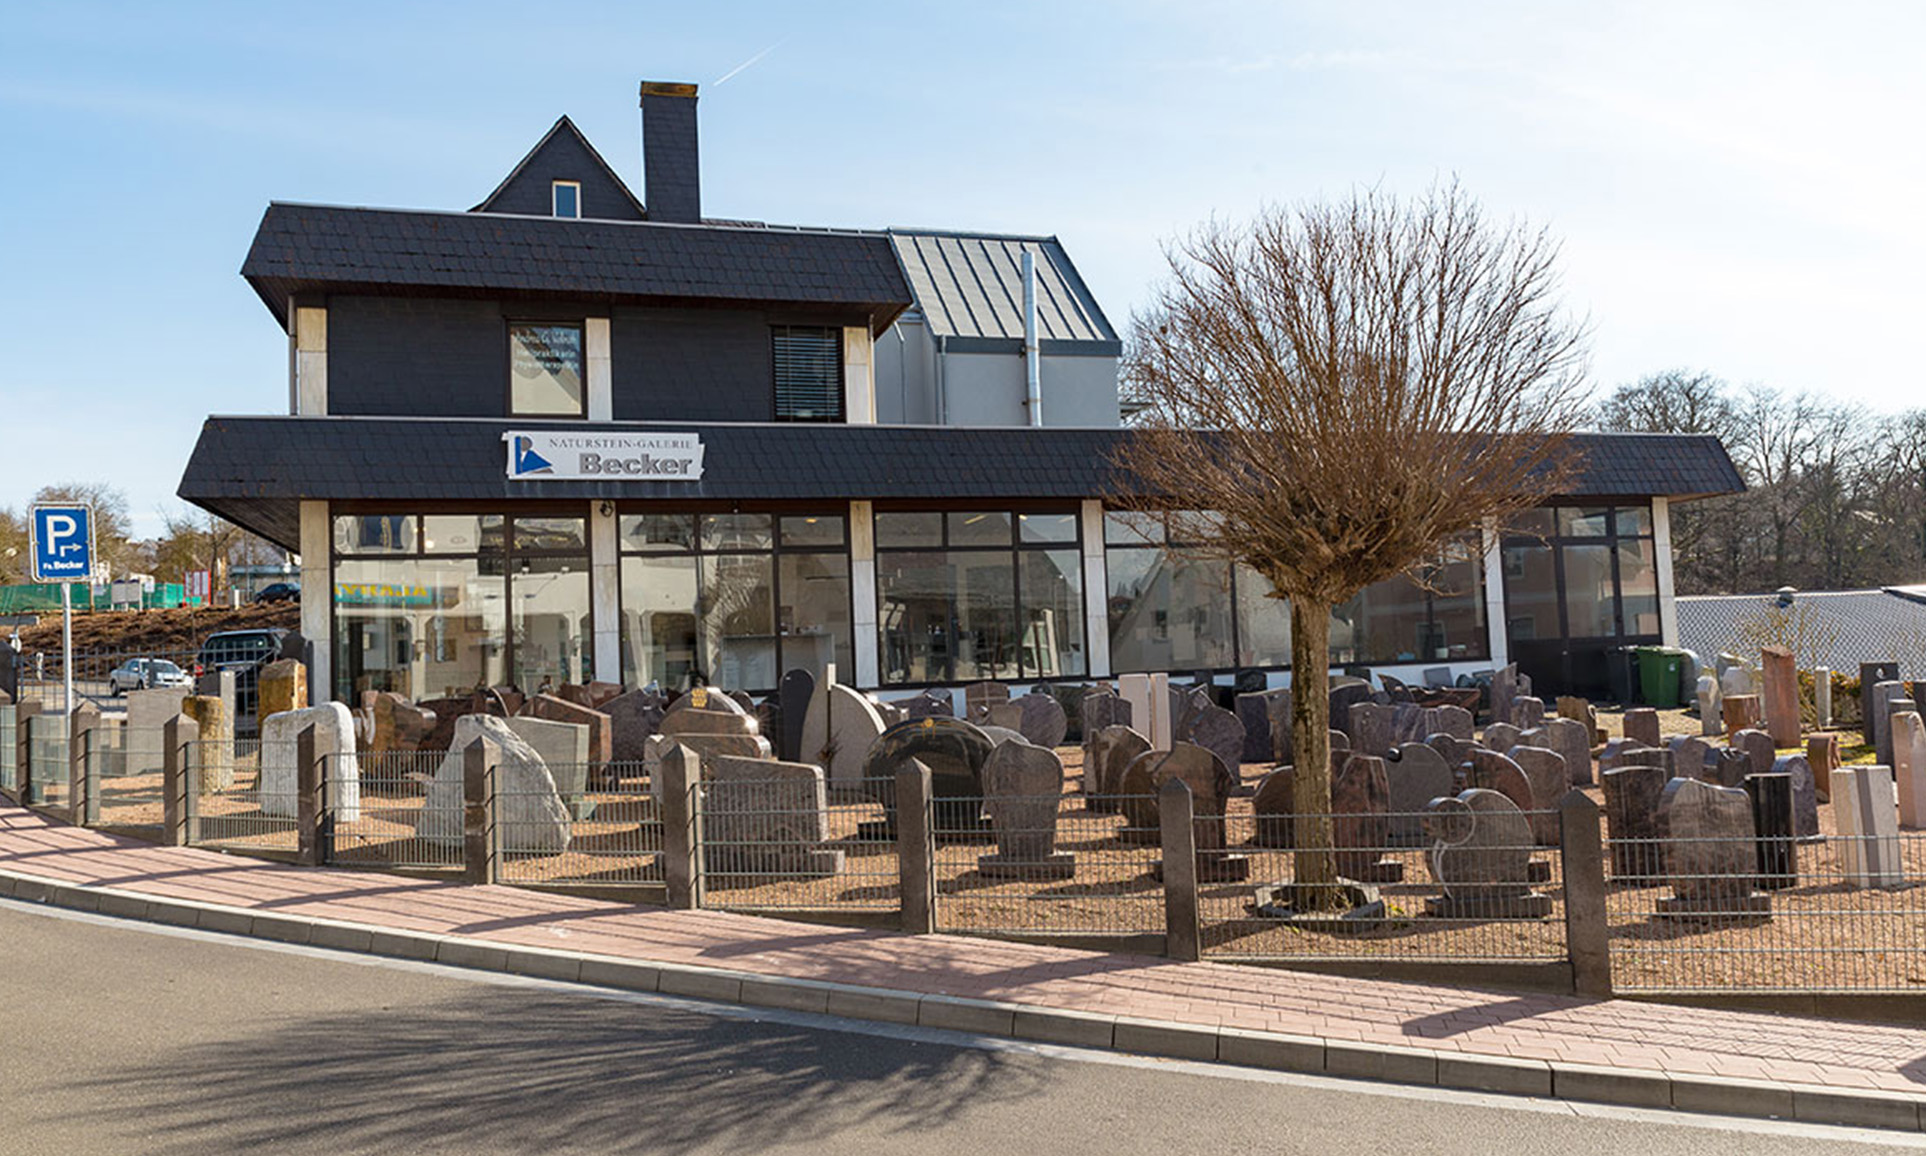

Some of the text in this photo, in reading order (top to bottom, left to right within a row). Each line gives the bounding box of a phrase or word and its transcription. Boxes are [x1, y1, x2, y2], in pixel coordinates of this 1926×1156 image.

[550, 438, 693, 449] NATURSTEIN-GALERIE
[579, 452, 693, 474] Becker
[46, 515, 77, 555] P
